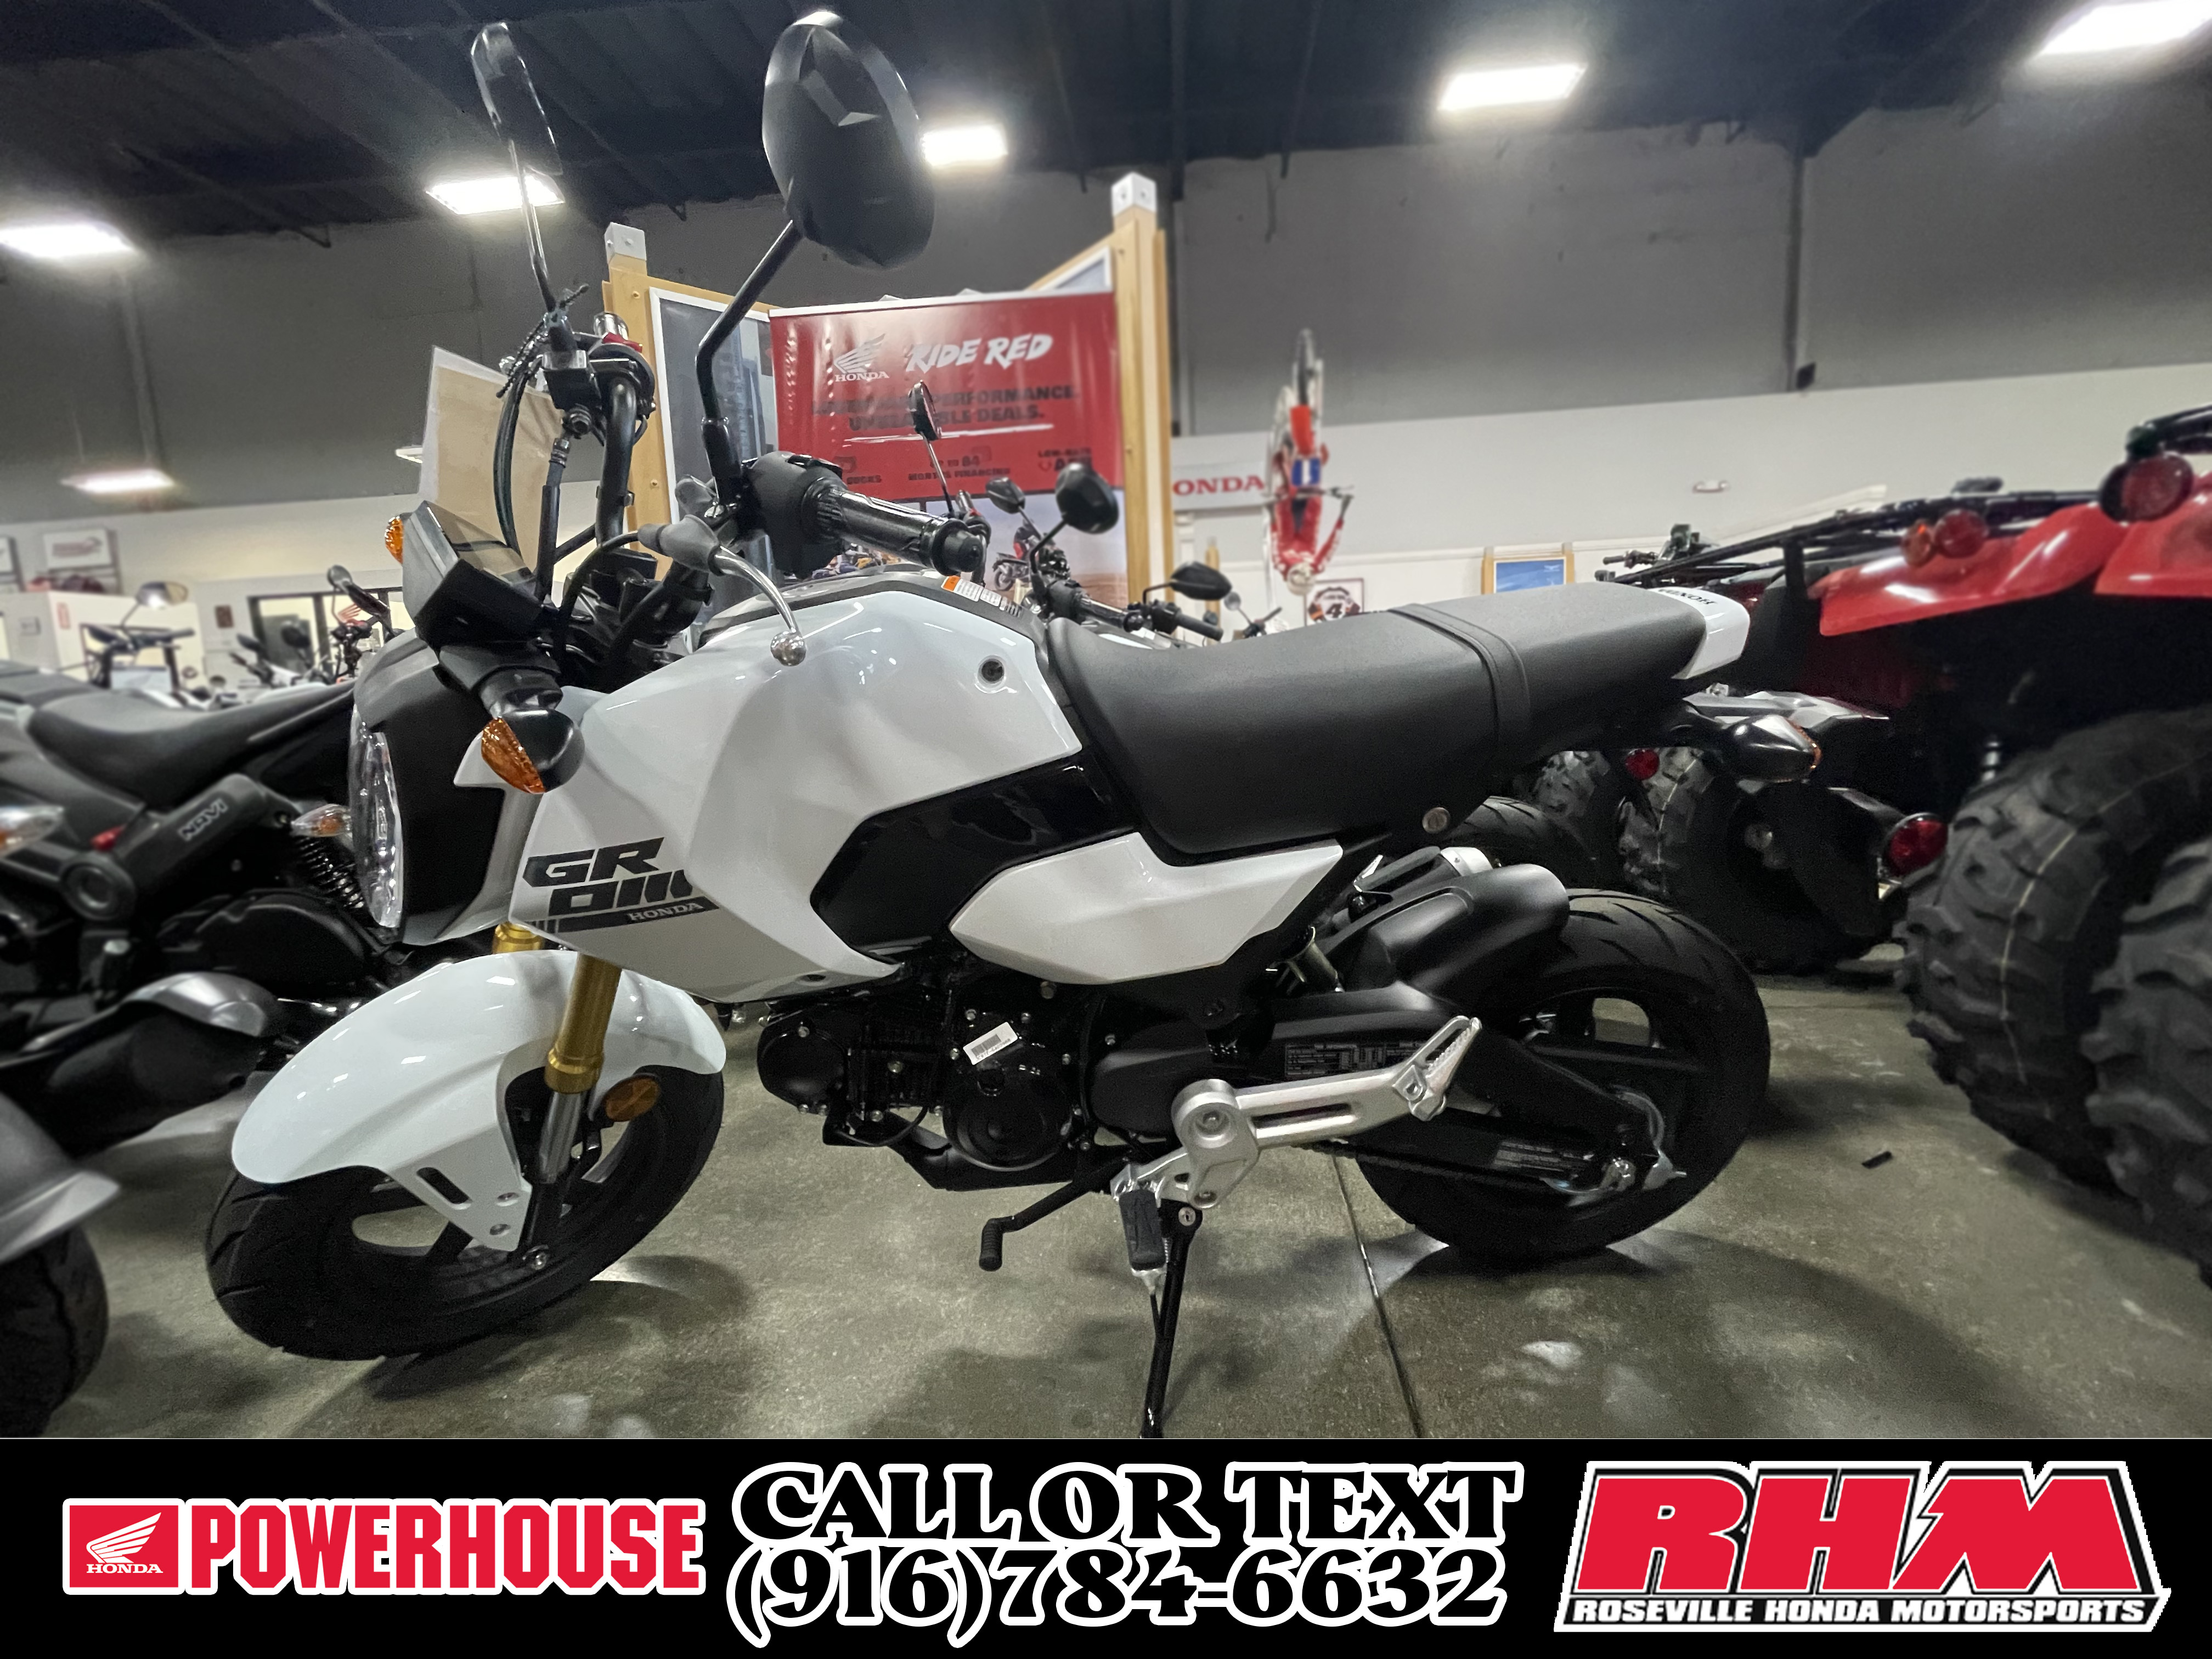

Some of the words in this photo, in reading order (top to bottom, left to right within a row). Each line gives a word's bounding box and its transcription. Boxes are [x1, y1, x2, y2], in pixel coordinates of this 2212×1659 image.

[906, 338, 982, 374] RIDE
[984, 333, 1053, 370] RED
[835, 371, 889, 382] HONDA
[178, 799, 228, 841] NAVI
[627, 902, 703, 922] HONDA
